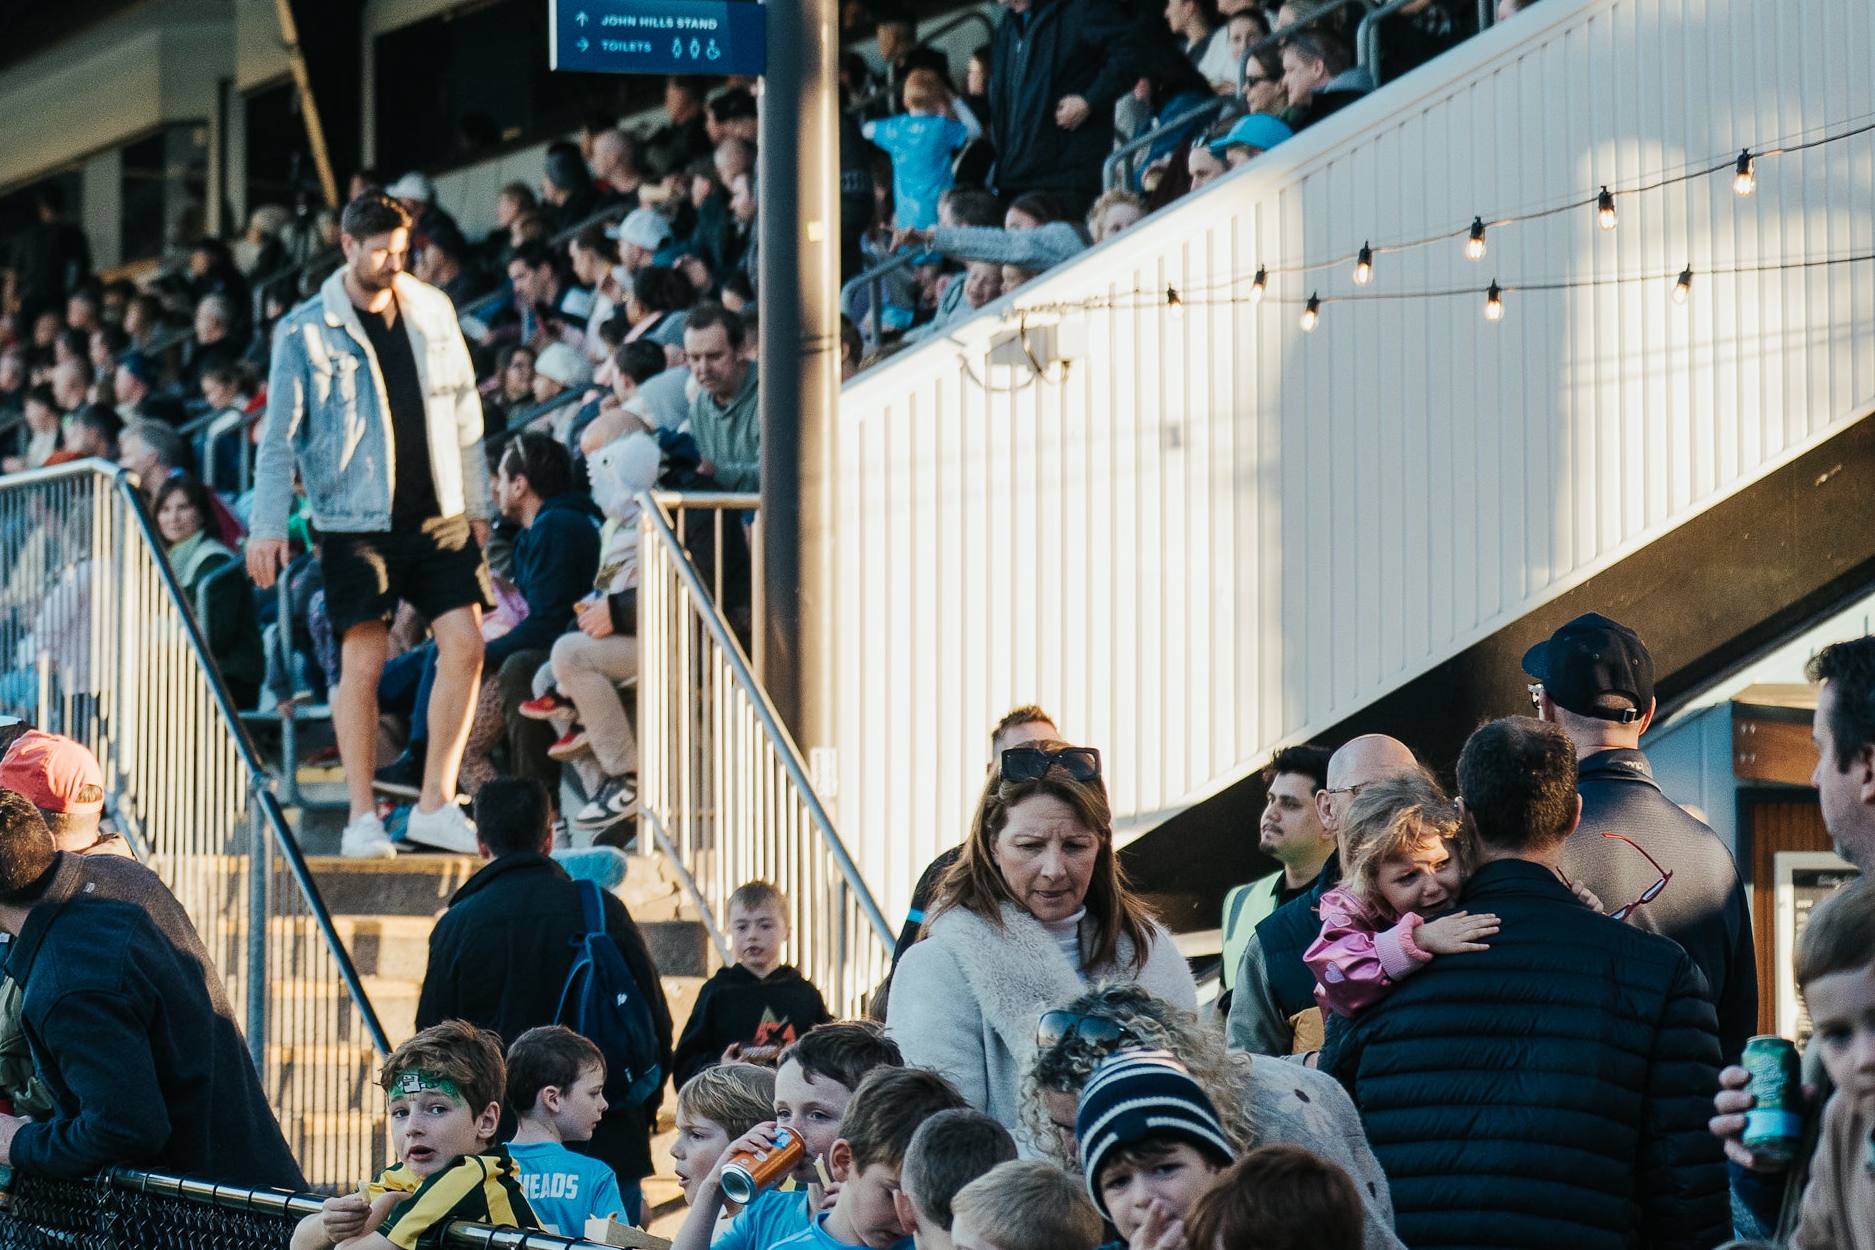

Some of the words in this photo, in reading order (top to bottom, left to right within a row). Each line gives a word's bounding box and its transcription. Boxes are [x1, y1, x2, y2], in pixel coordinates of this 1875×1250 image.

[601, 13, 637, 27] JOHN
[639, 15, 674, 29] HILLS
[676, 17, 718, 30] STAND
[601, 39, 652, 53] TOILETS
